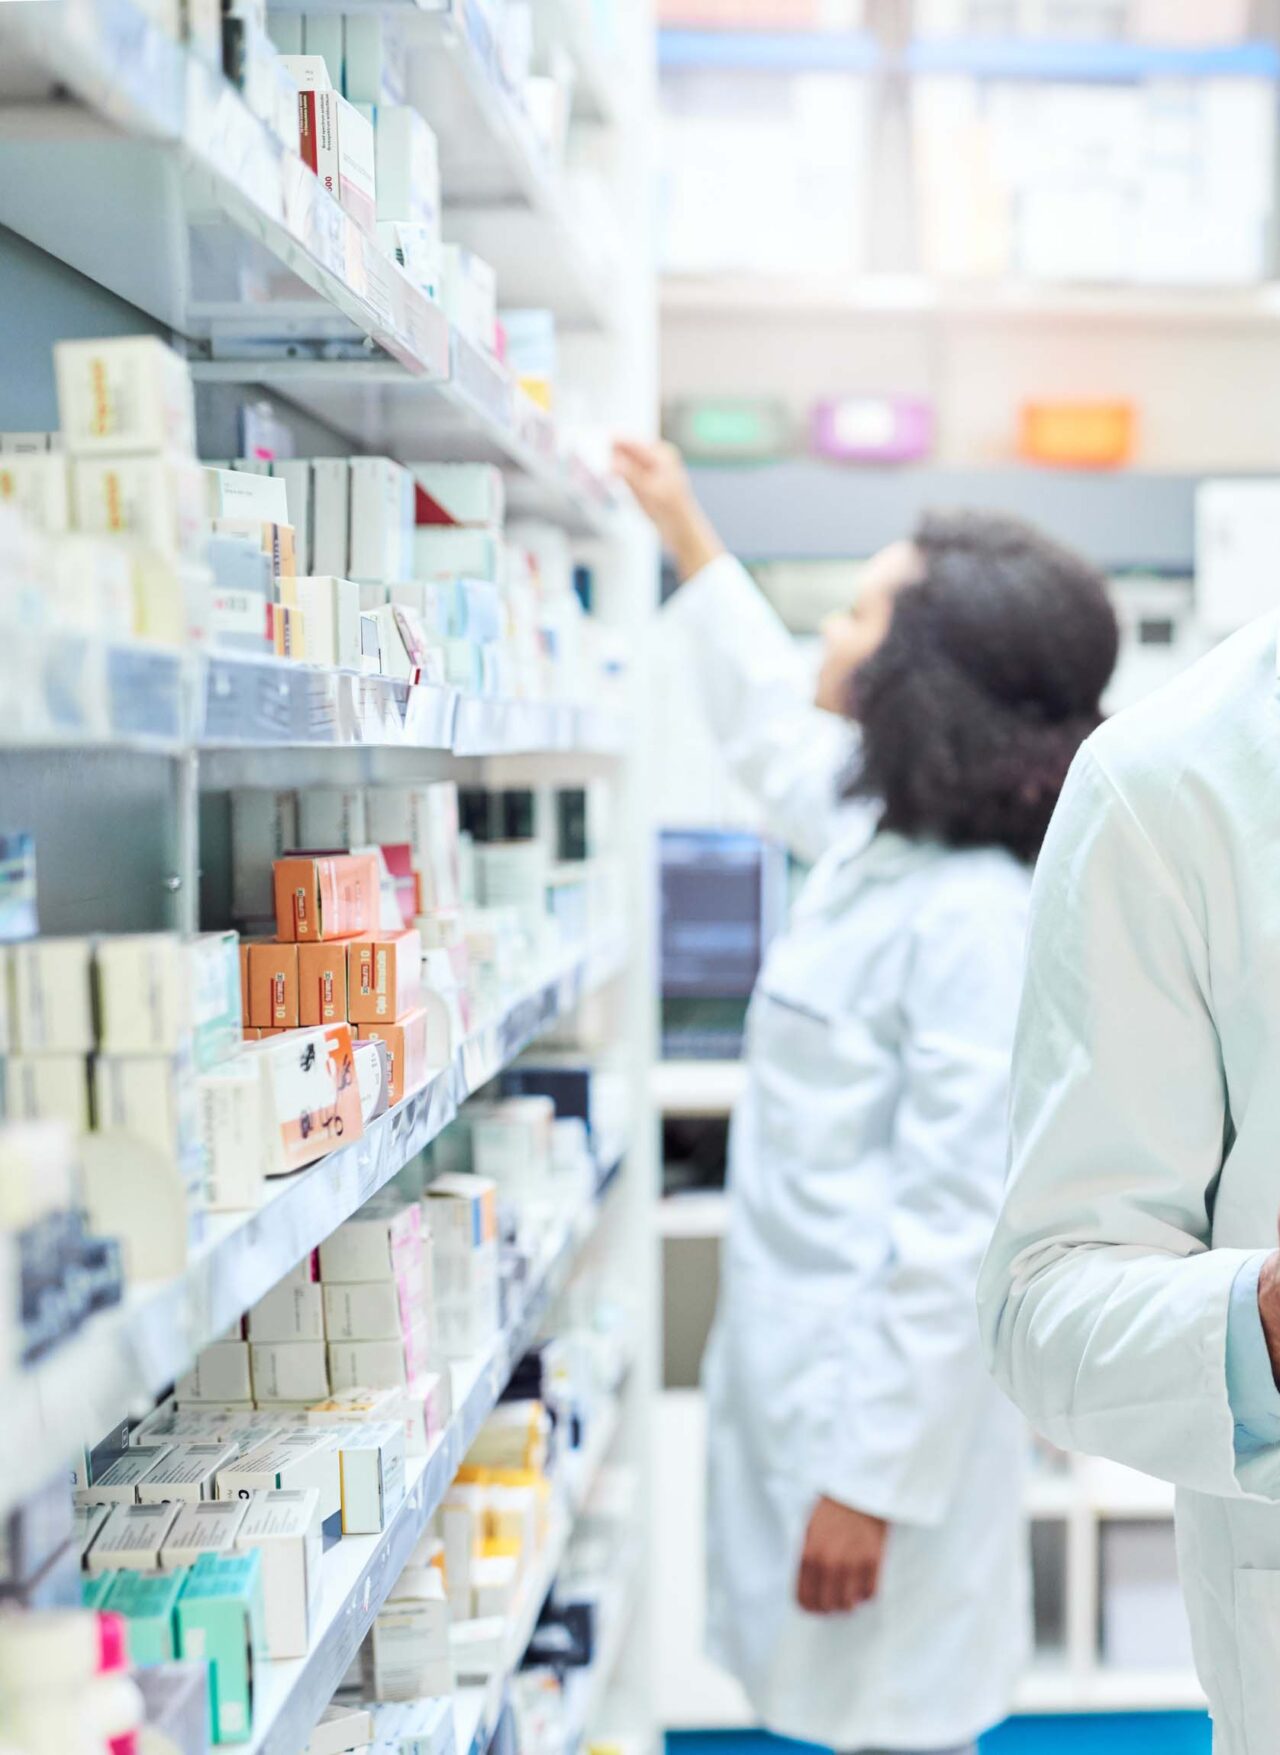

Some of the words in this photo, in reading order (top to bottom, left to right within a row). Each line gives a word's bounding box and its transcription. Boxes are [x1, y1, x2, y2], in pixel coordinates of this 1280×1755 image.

[298, 921, 308, 933] 10
[360, 950, 370, 962] 10
[275, 1006, 286, 1018] 10
[324, 1004, 334, 1017] 10
